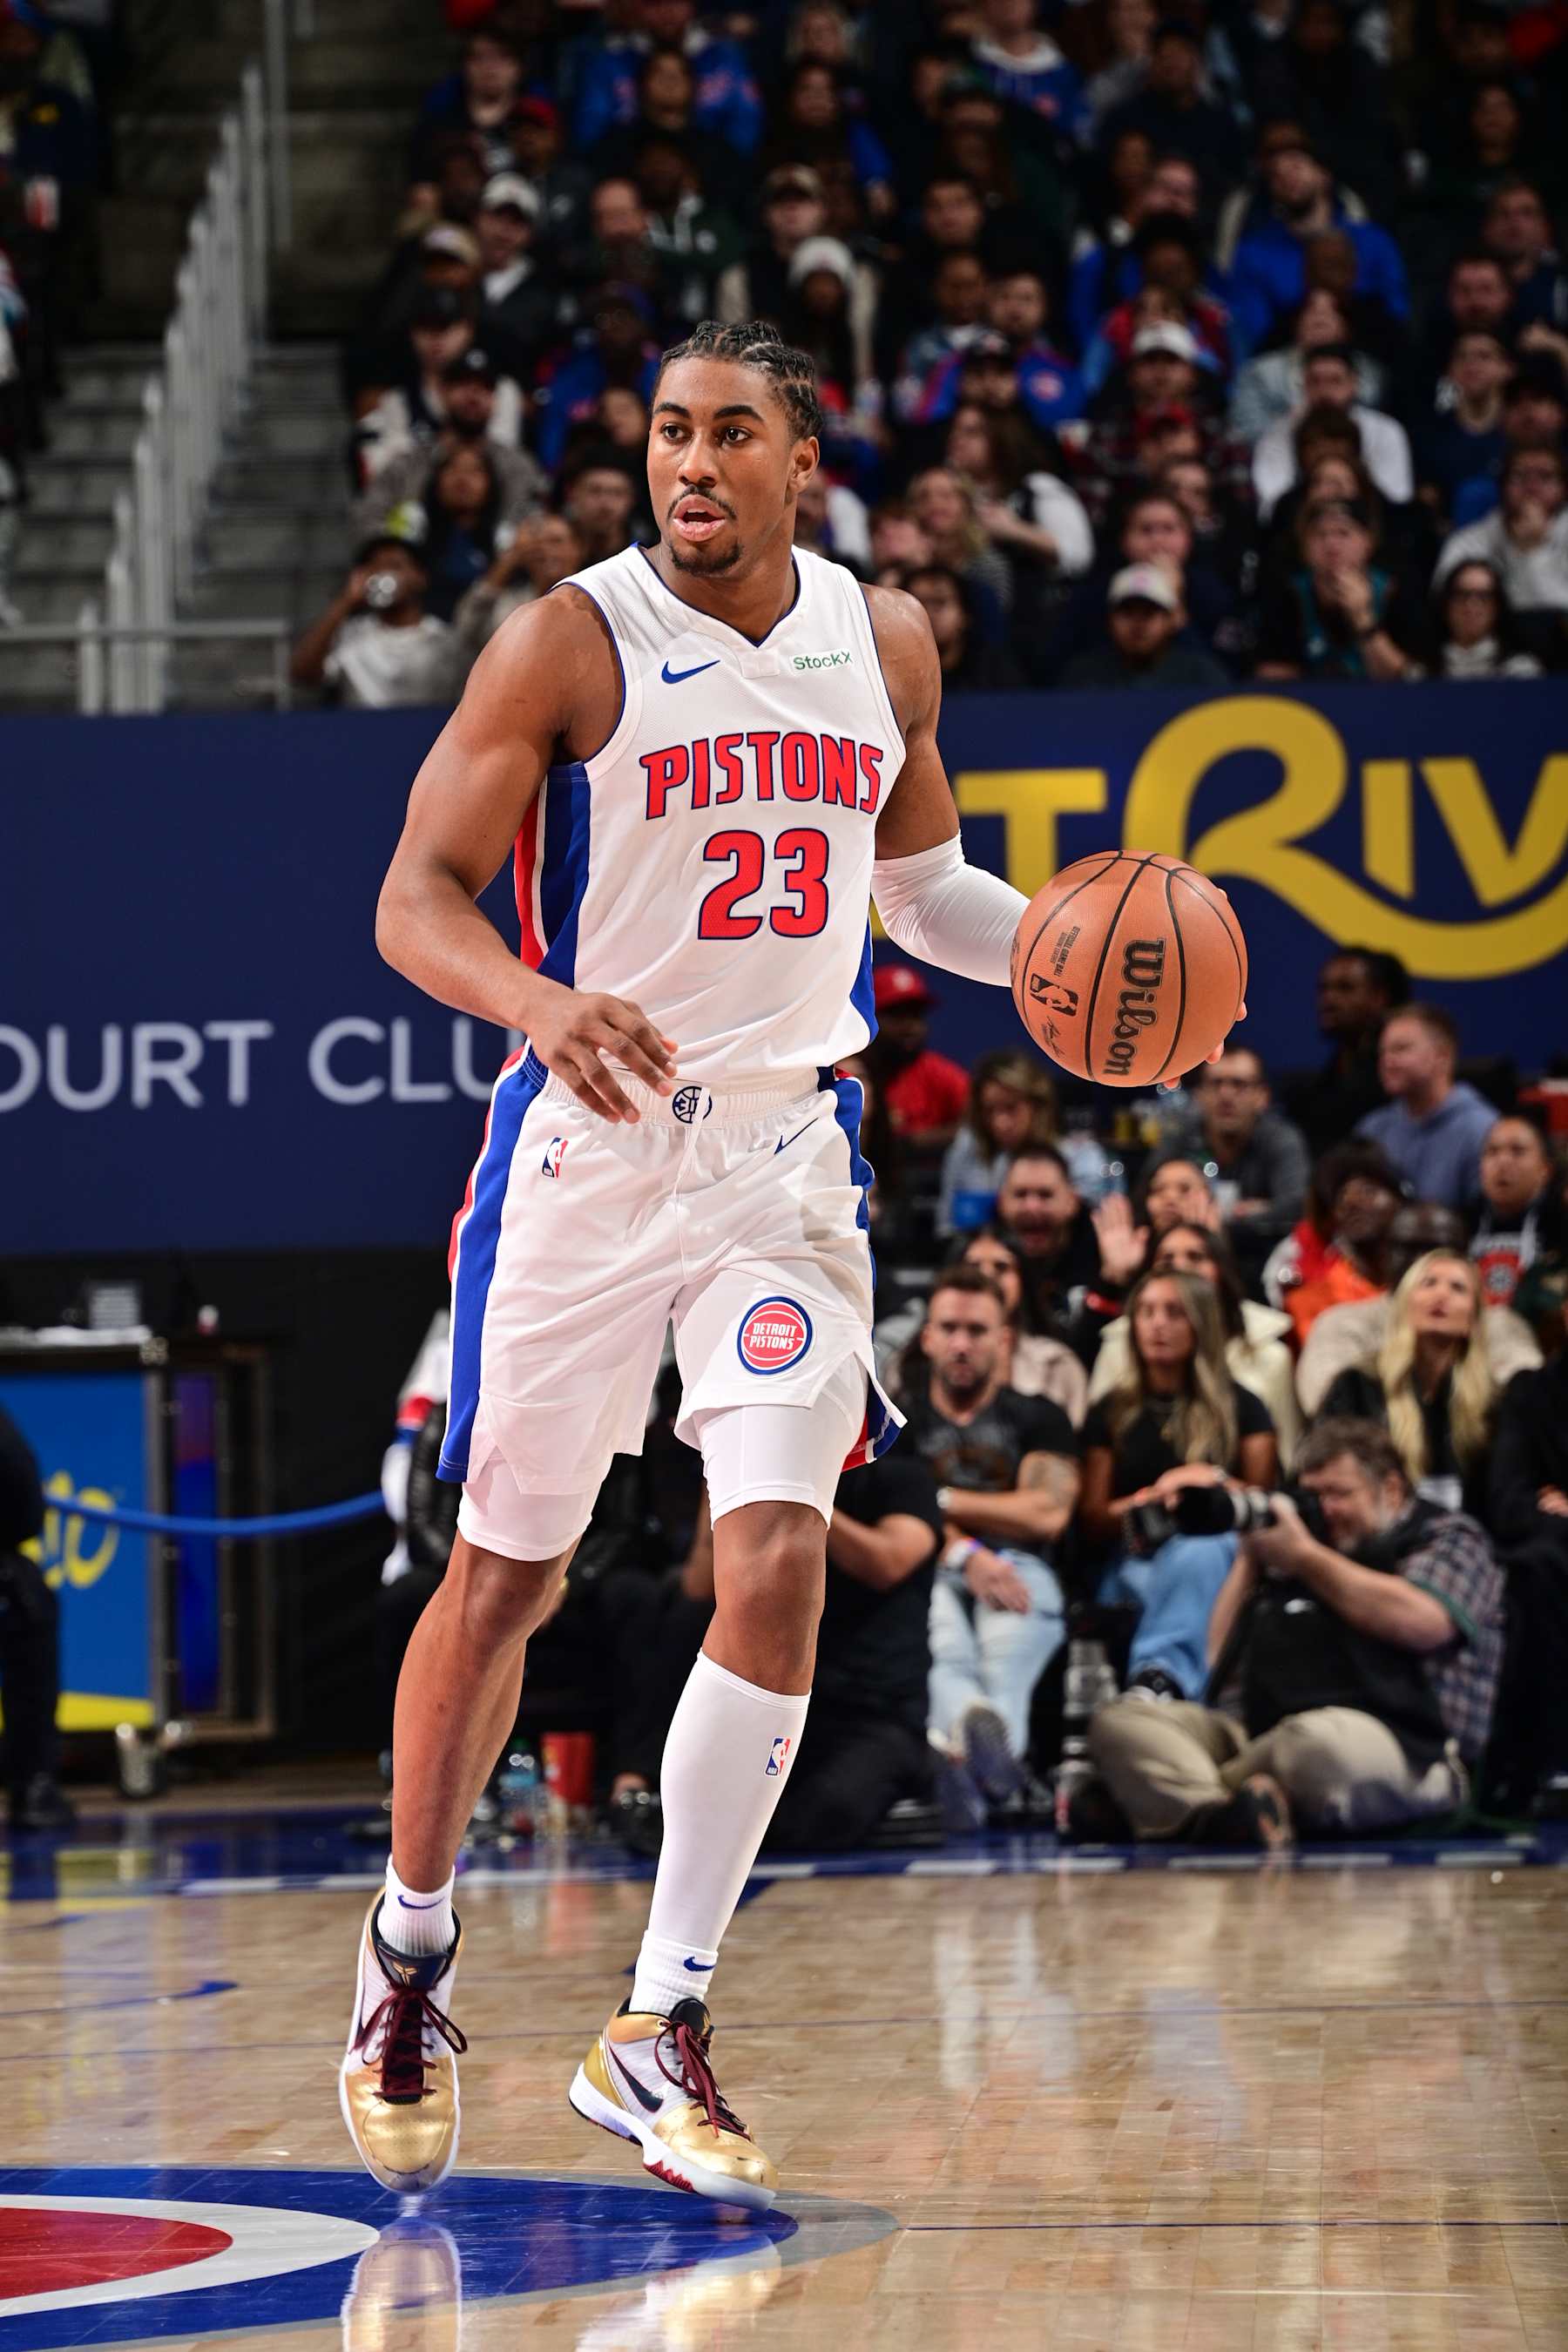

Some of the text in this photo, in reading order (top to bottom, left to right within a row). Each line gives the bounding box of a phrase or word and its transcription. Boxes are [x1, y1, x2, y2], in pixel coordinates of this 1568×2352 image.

[793, 650, 854, 670] StockX
[639, 731, 883, 820] PISTONS
[698, 828, 829, 941] 23
[1102, 936, 1167, 1076] Wilson
[749, 1335, 794, 1349] PISTONS
[753, 1322, 797, 1336] DETROIT
